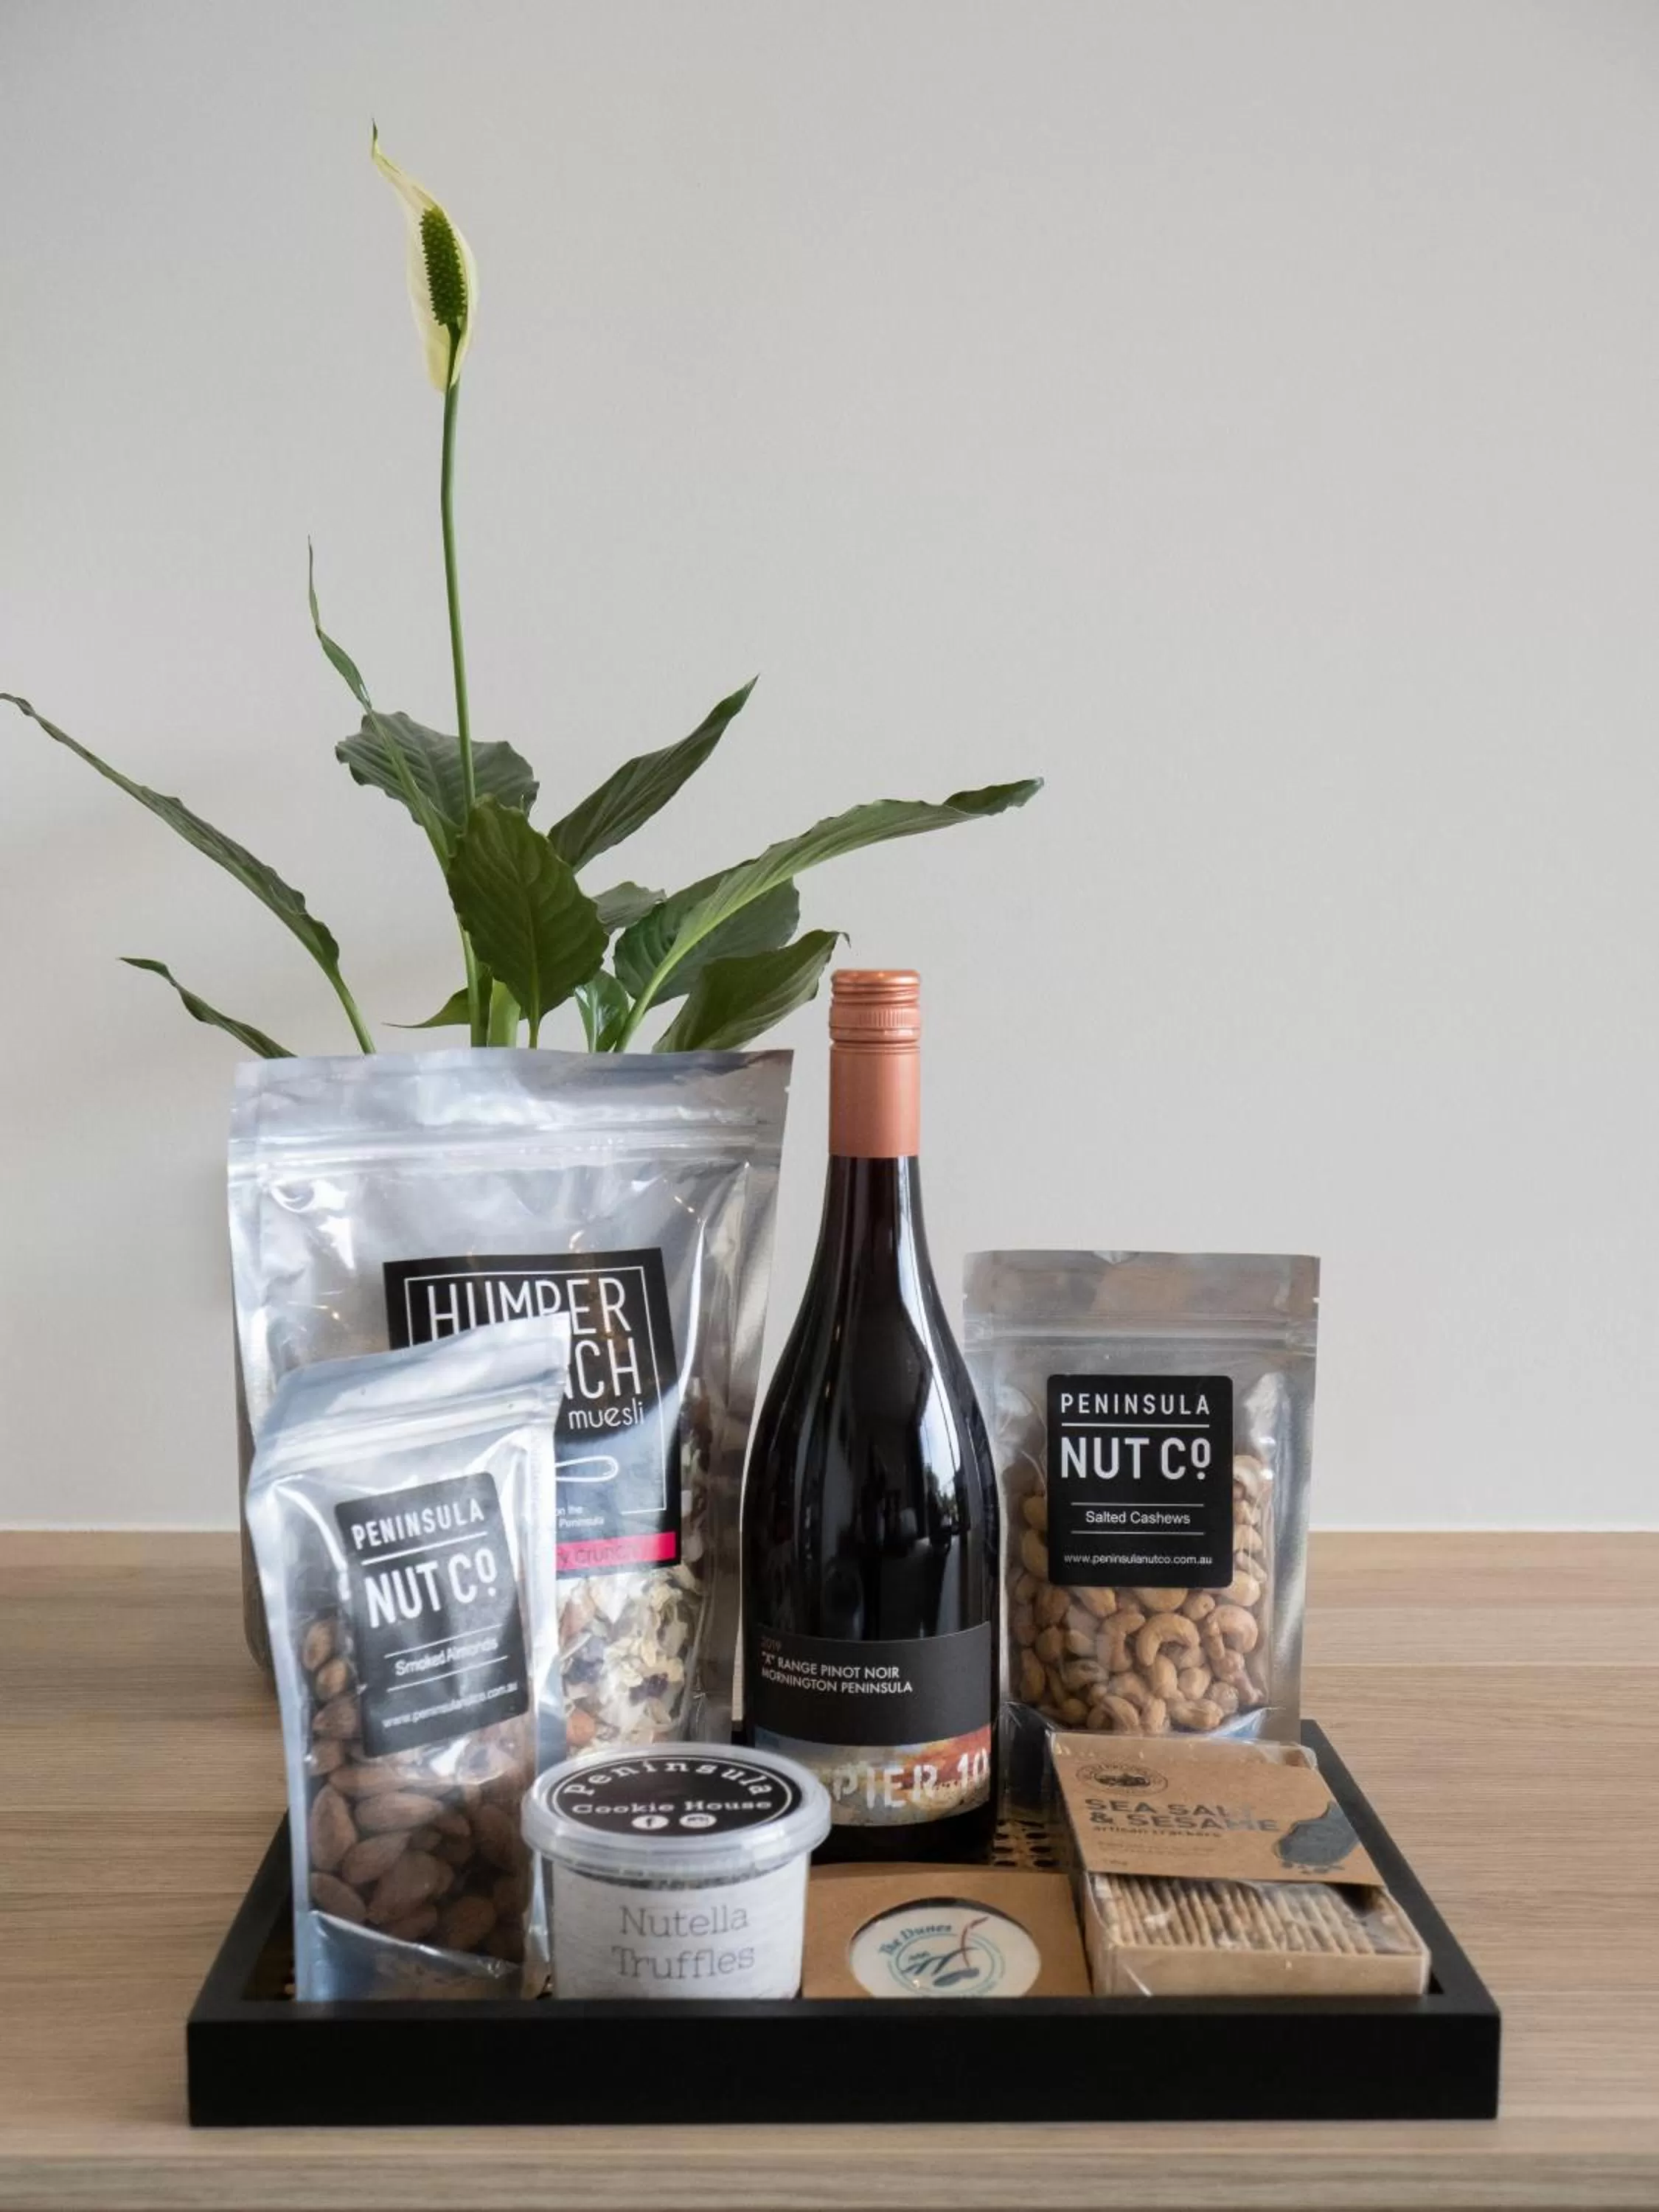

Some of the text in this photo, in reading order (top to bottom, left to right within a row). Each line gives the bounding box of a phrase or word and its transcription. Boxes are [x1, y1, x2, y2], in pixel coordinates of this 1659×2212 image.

[568, 1398, 644, 1430] muesli
[1061, 1393, 1210, 1415] PENINSULA
[1061, 1437, 1150, 1479] NUT
[350, 1498, 484, 1550] PENINSULA
[1085, 1511, 1191, 1525] Salted Cashews
[365, 1560, 441, 1629] NUT
[761, 1667, 914, 1694] MORNINGTON PENINSULA
[778, 1657, 818, 1675] RANGE
[821, 1665, 861, 1679] PINOT
[864, 1666, 900, 1679] NOIR
[563, 1761, 772, 1795] Peninsula
[831, 1762, 937, 1809] PIER
[572, 1800, 772, 1814] Cookie House
[1085, 1798, 1157, 1813] SEA
[1090, 1811, 1113, 1825] &
[620, 1905, 751, 1938] Nutella
[611, 1945, 755, 1980] Truffles
